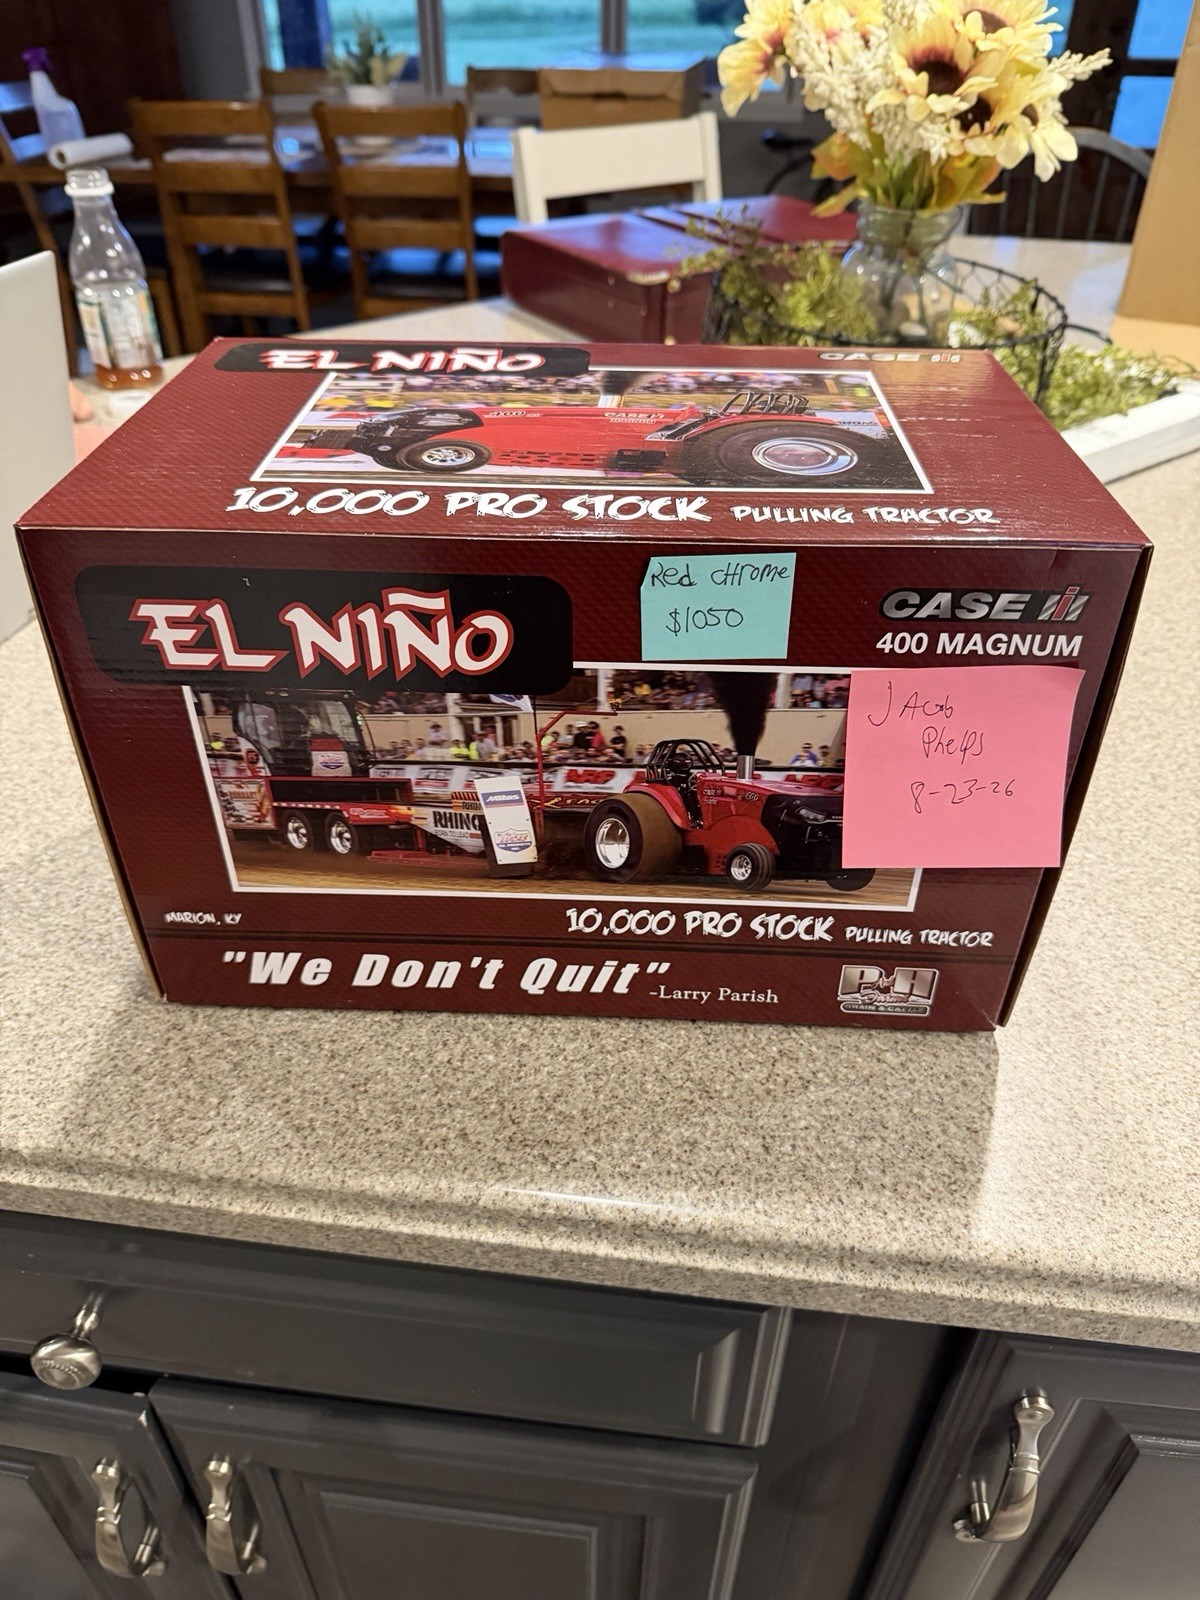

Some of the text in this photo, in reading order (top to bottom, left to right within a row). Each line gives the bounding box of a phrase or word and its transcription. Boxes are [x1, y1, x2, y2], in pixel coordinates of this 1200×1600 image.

[259, 347, 547, 373] EL NIÑO
[819, 352, 920, 362] CASE
[225, 486, 1001, 525] 10,000 PRO STOCK PULLING TRACTOR
[651, 562, 698, 588] Red
[882, 590, 1032, 620] CASE
[128, 587, 513, 682] EL NIÑO
[666, 606, 744, 637] $1050
[876, 631, 1083, 657] 400 MAGNUM
[910, 778, 1016, 814] 8-23-26
[164, 911, 243, 926] MARION, KY
[565, 907, 994, 948] 10,000 PRO STOCK PULLING TRACTOR
[351, 953, 504, 990] Don't
[717, 987, 780, 1004] Parish
